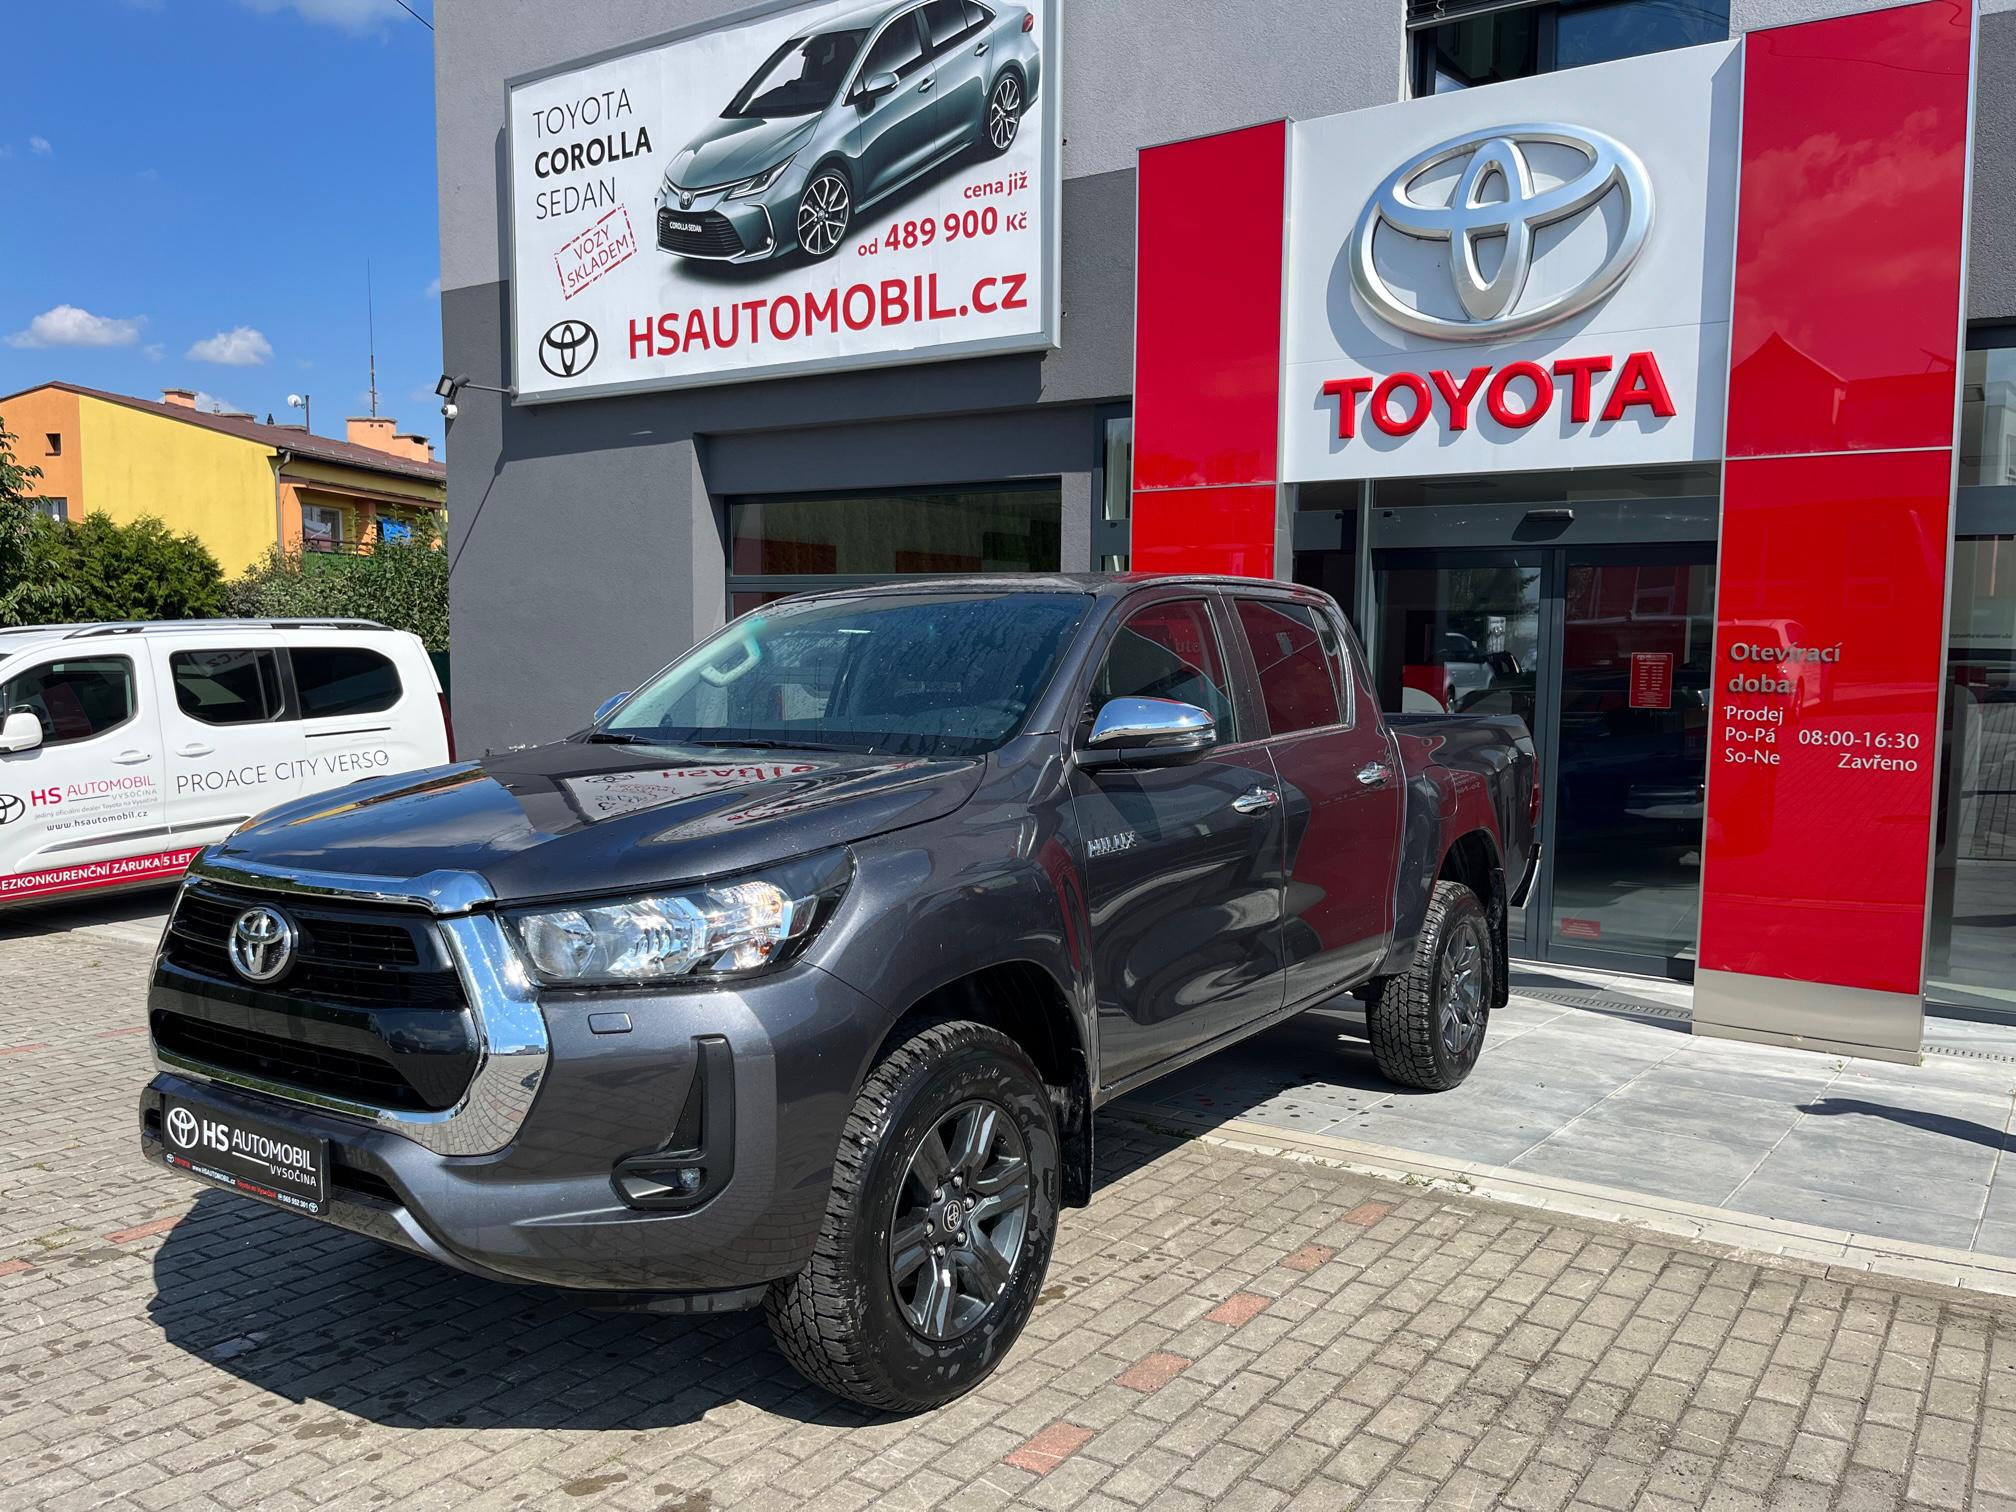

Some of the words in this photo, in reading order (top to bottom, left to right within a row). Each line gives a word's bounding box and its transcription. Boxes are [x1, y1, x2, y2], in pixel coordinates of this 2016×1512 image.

[533, 88, 633, 138] TOYOTA
[534, 127, 653, 178] COROLLA
[536, 177, 617, 220] SEDAN
[963, 181, 1003, 200] cena
[1006, 172, 1028, 196] již
[573, 224, 610, 260] VOZY
[670, 222, 688, 231] COROLLA
[688, 224, 702, 232] SEDAN
[858, 237, 879, 257] od
[884, 217, 936, 252] 489
[945, 207, 998, 243] 900
[1006, 213, 1028, 233] Kč
[567, 236, 629, 288] SKLADEM
[628, 273, 1028, 359] HSAUTOMOBIL.CZ
[1323, 351, 1677, 439] TOYOTA
[1729, 641, 1843, 664] Otevírací
[1728, 674, 1796, 693] doba:
[1725, 705, 1784, 726] Prodej
[1724, 726, 1776, 744] Po-Pá
[1798, 729, 1920, 750] 08:00-16:30
[176, 764, 268, 795] PROACE
[275, 757, 319, 783] CITY
[325, 750, 389, 774] VERSO
[1724, 747, 1780, 765] So-Ne
[1838, 753, 1918, 772] Zavřeno
[31, 787, 62, 807] HS
[67, 775, 156, 798] AUTOMOBIL
[102, 801, 122, 811] Toyota
[46, 810, 148, 832] www.hsautomobil.cz
[1088, 831, 1137, 858] HILUX
[0, 862, 110, 891] EZKONKURENČNÍ
[112, 857, 160, 875] ZÁRUKA
[162, 857, 170, 867] 5
[172, 853, 192, 865] LET
[203, 1119, 228, 1151] HS
[232, 1128, 317, 1172] AUTOMOBIL
[270, 1164, 317, 1187] VYSOČINA
